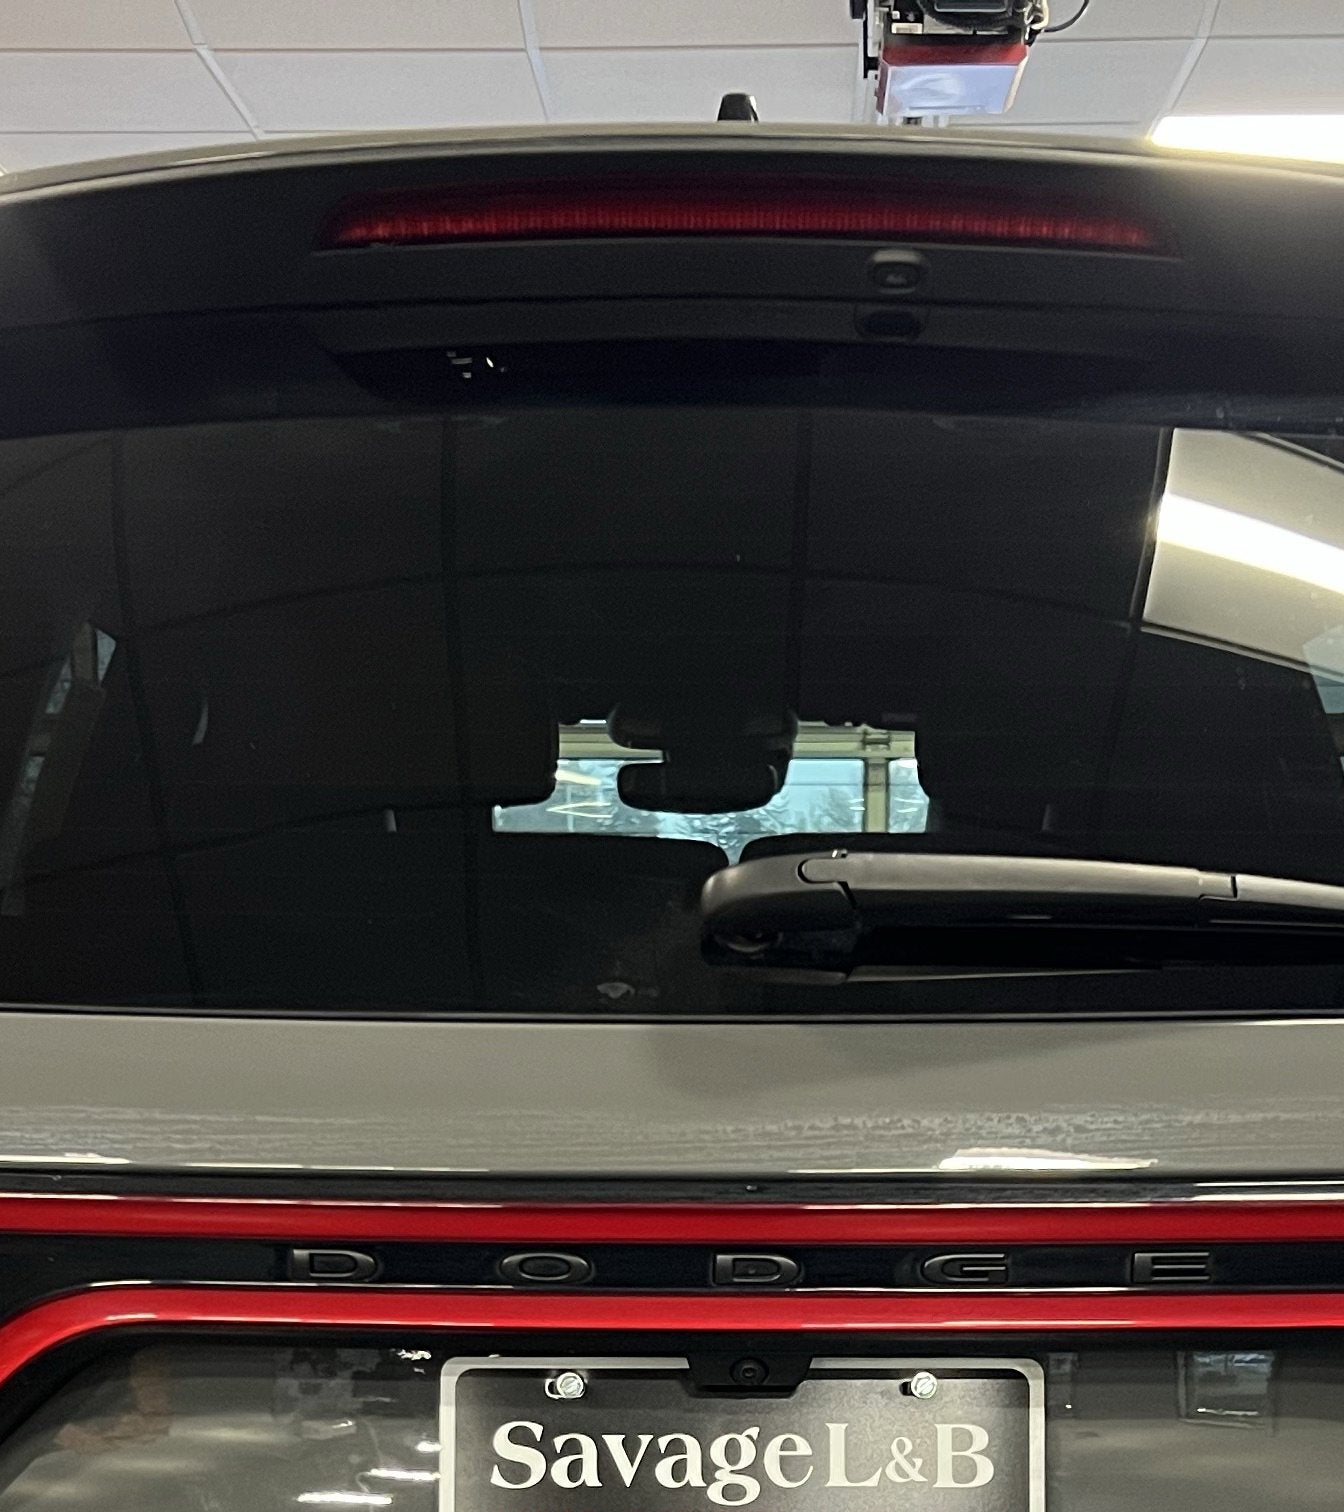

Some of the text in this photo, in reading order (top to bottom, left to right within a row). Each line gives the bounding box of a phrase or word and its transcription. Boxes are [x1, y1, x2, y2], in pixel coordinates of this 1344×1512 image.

[288, 1248, 1212, 1287] DODGE
[490, 1420, 996, 1506] Savage L&B
